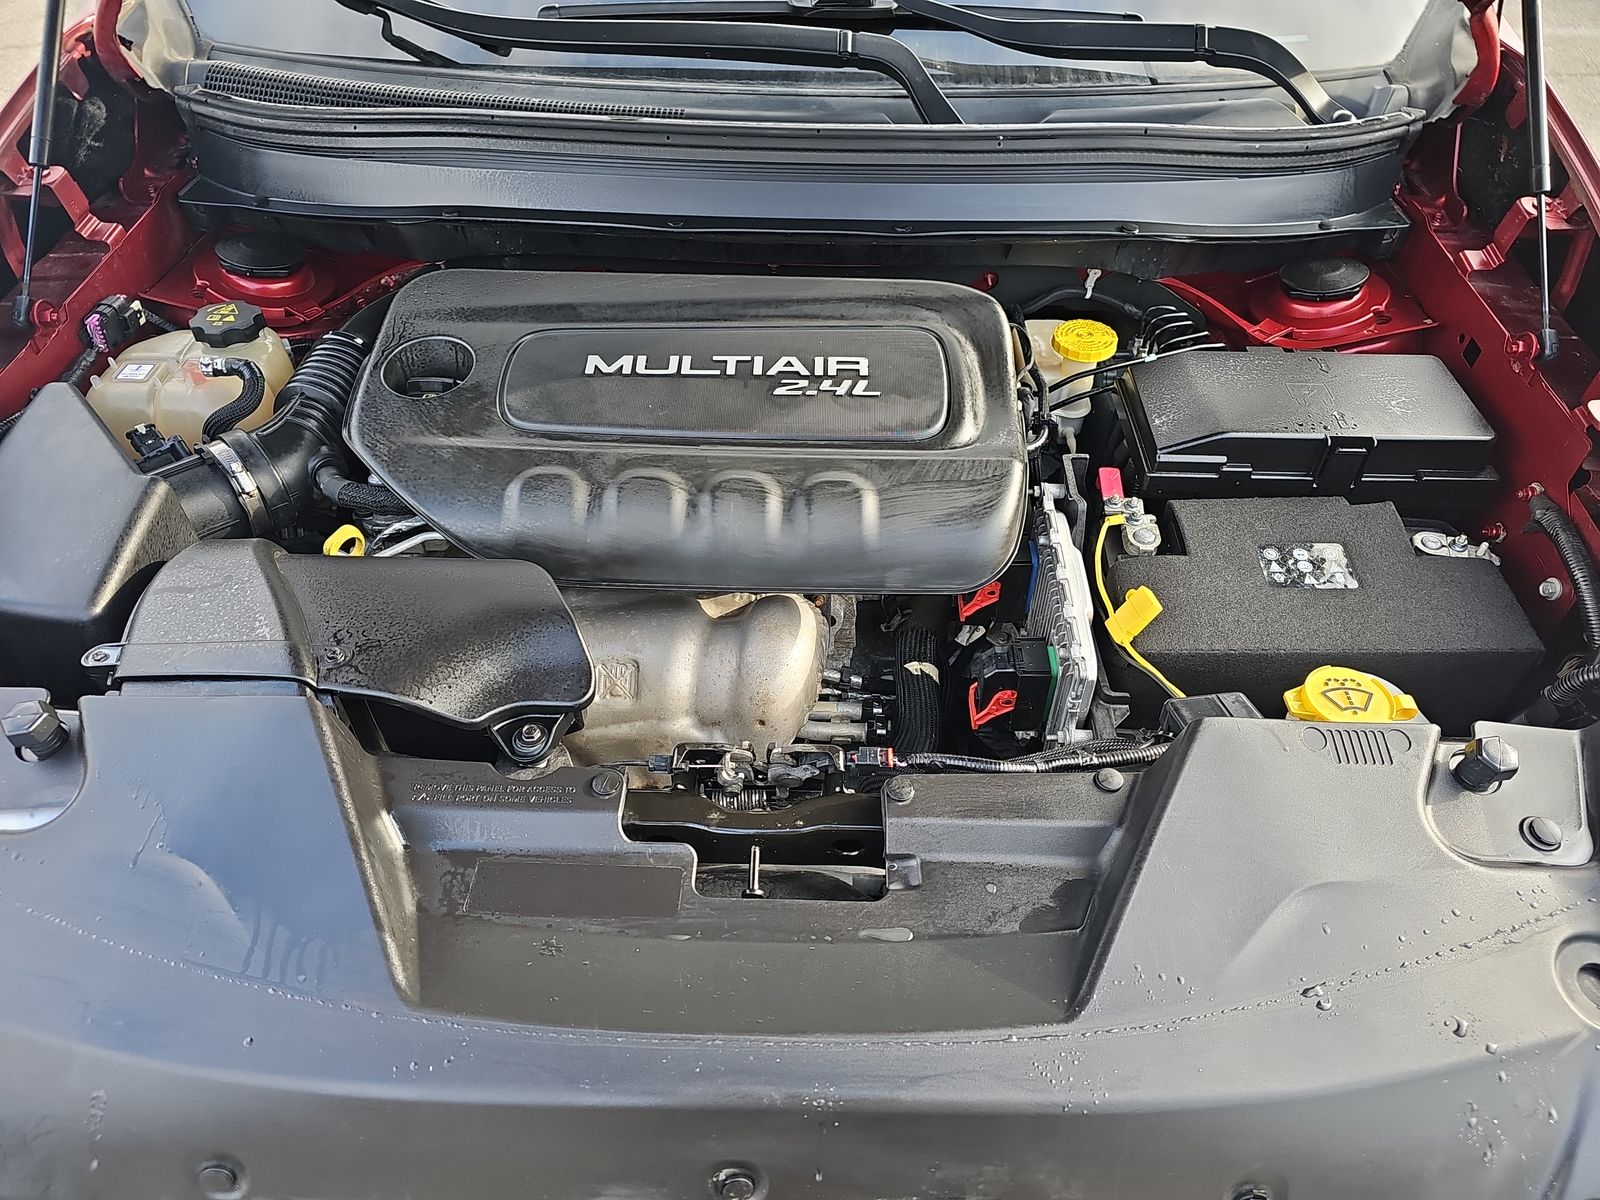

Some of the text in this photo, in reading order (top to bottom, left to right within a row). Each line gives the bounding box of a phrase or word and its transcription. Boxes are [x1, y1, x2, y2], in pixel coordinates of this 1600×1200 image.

[585, 355, 869, 376] MULTIAIR
[772, 379, 881, 397] 2.4L
[413, 784, 577, 794] REMOVE THIS PANEL FOR ACCESS TO
[433, 793, 453, 802] FILL
[455, 794, 481, 802] PORT
[482, 794, 499, 802] ON
[499, 795, 526, 803] SOME
[529, 795, 573, 804] VEHICLES
